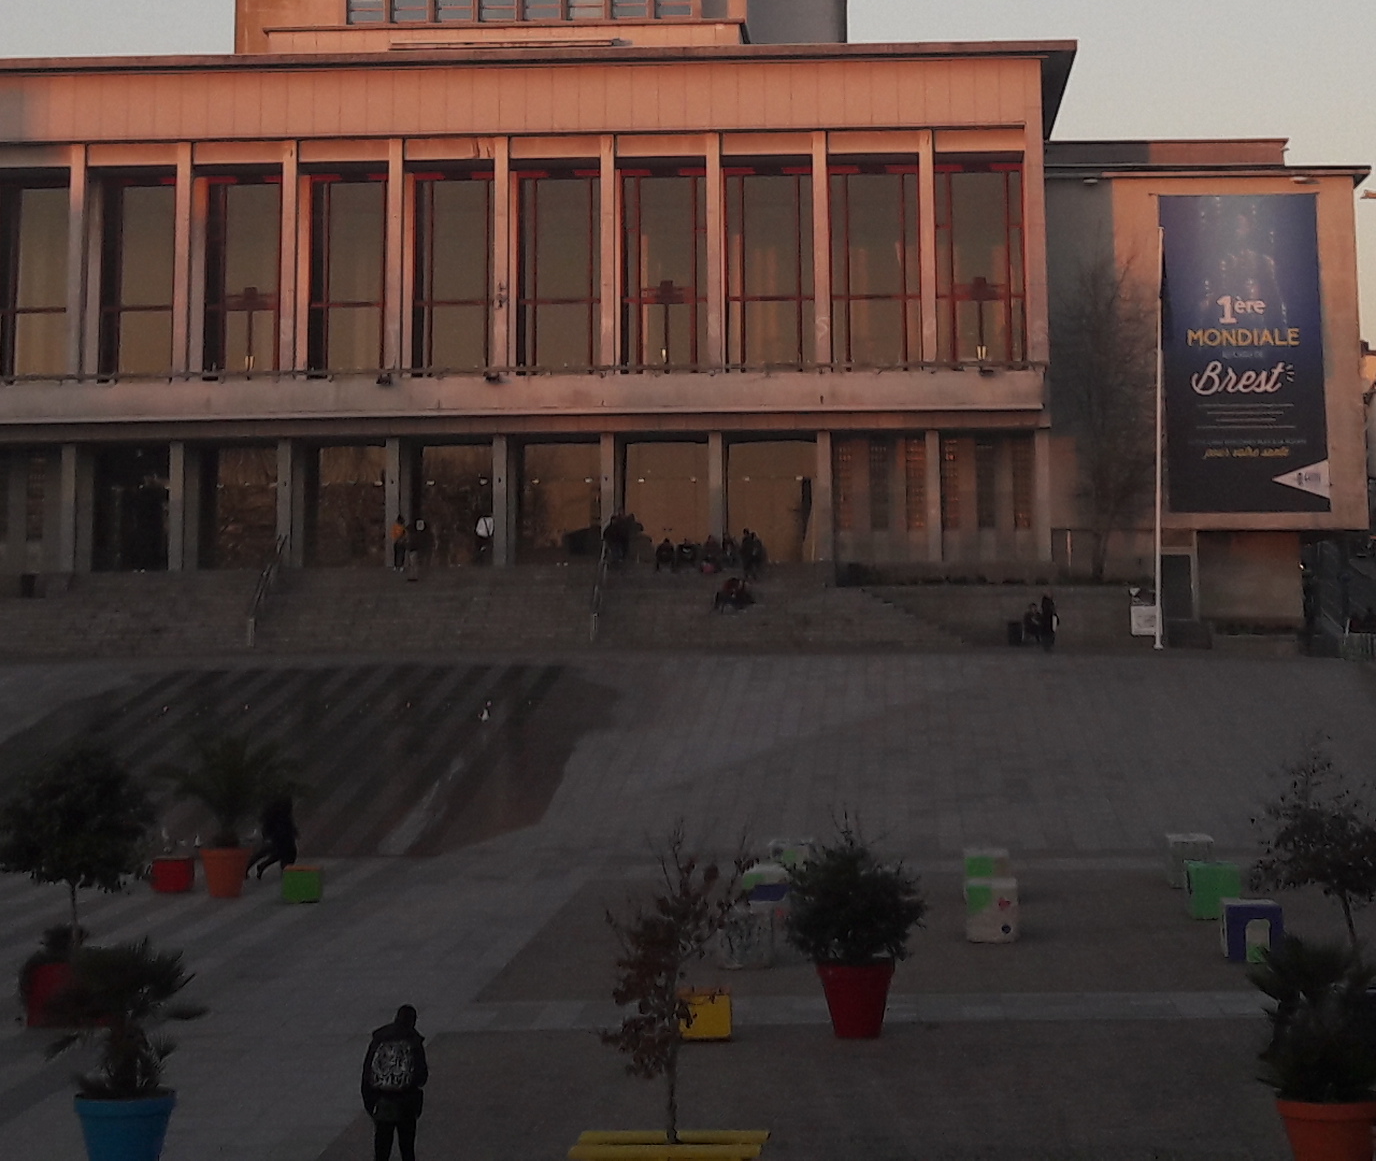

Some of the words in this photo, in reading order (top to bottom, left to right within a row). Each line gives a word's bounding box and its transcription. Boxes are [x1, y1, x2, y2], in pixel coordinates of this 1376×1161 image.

[1216, 295, 1266, 324] 1ère
[1186, 327, 1301, 347] MONDIALE
[1191, 360, 1286, 396] Brest
